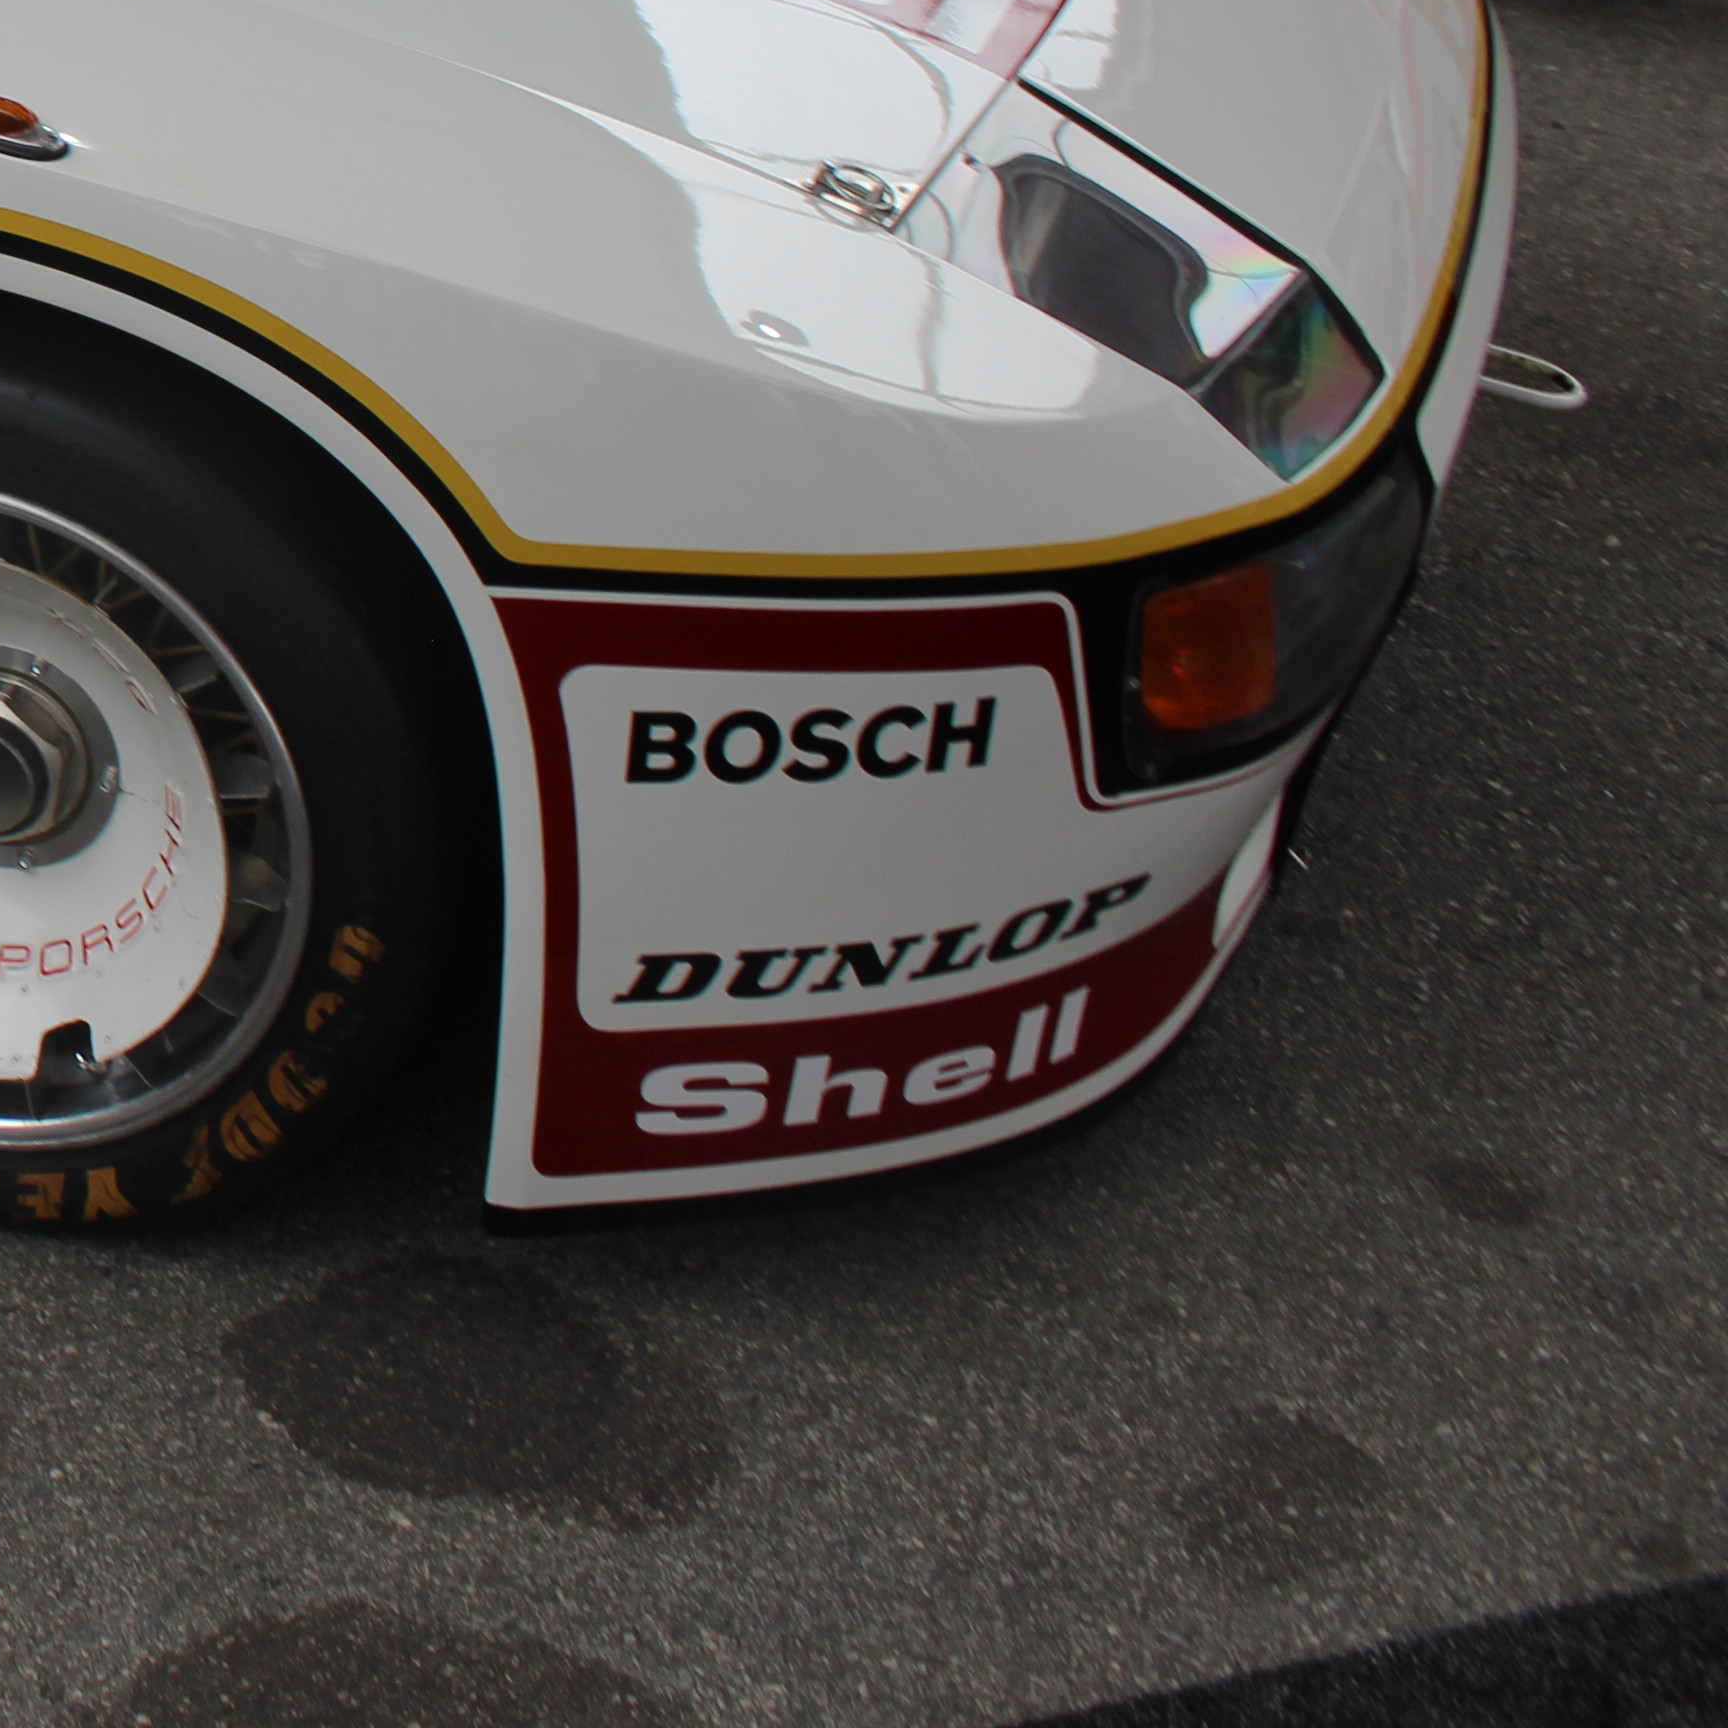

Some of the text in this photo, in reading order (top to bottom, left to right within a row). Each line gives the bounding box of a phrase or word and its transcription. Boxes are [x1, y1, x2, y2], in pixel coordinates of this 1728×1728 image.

[624, 696, 999, 784] BOSCH
[612, 873, 1151, 1005] DUNLOP
[635, 985, 1091, 1137] Shell
